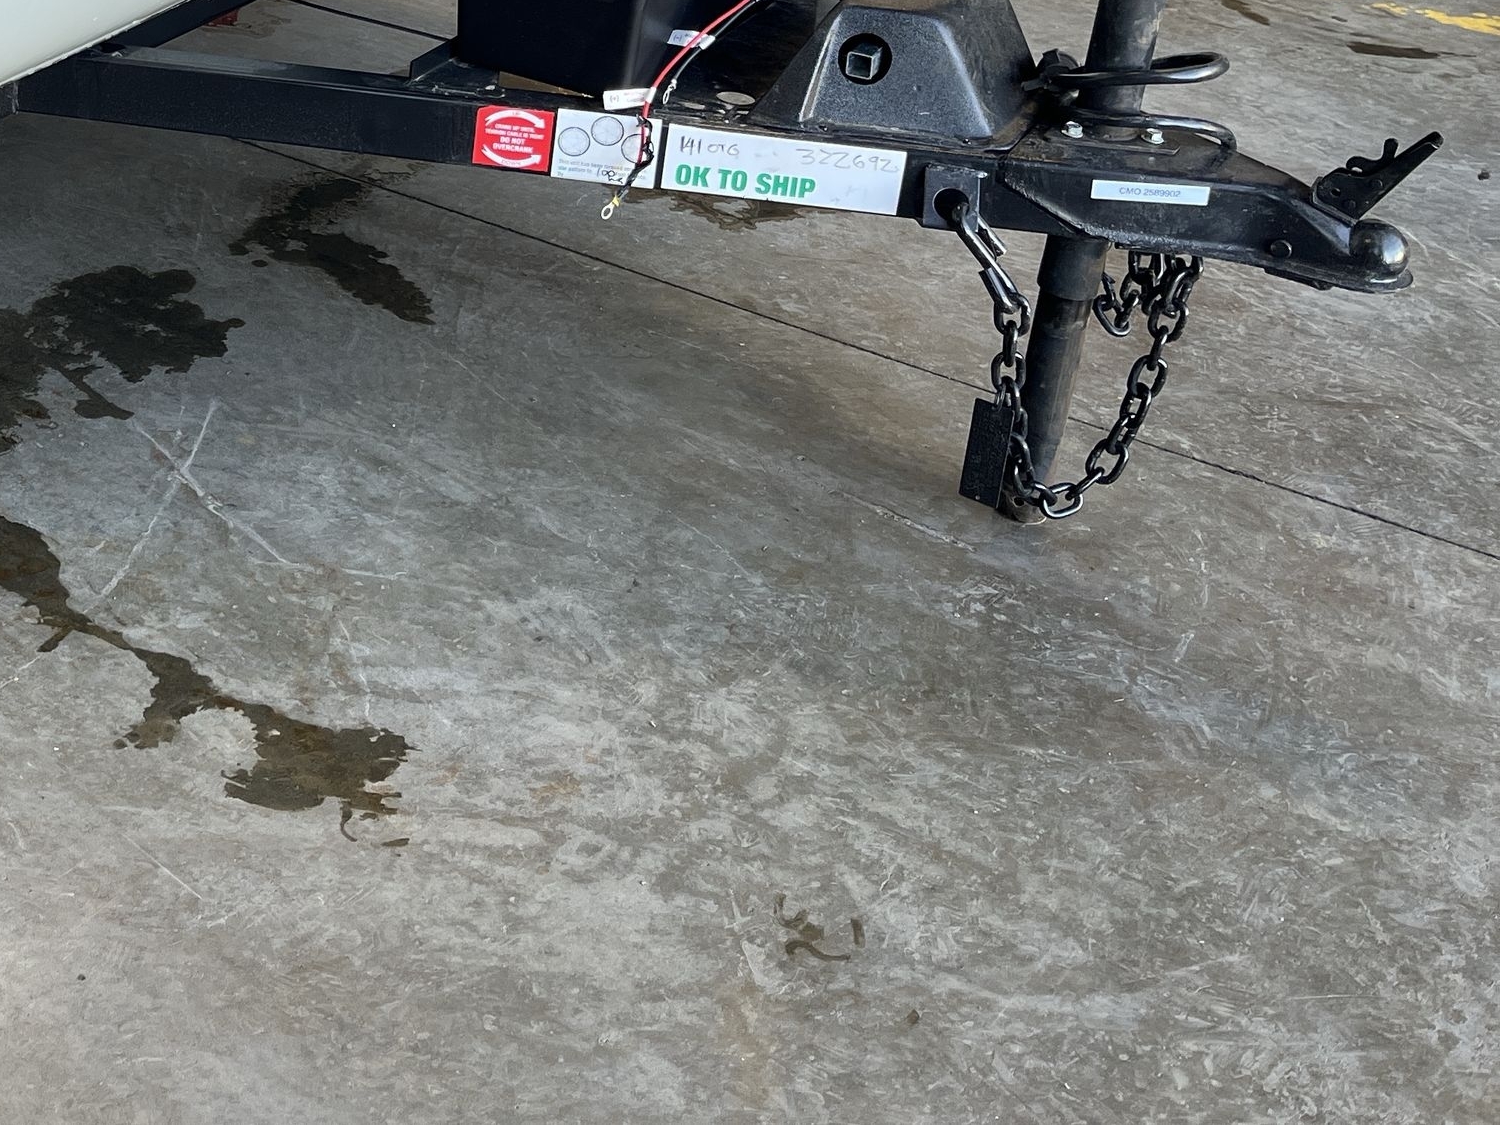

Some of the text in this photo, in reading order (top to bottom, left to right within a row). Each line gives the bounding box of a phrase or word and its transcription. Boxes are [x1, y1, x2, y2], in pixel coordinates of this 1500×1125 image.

[500, 136, 511, 144] DO
[492, 142, 534, 153] OVERCRANK
[796, 148, 894, 172] 322692
[674, 163, 817, 199] OK TO SHIP
[1119, 187, 1181, 198] CMO 2589902
